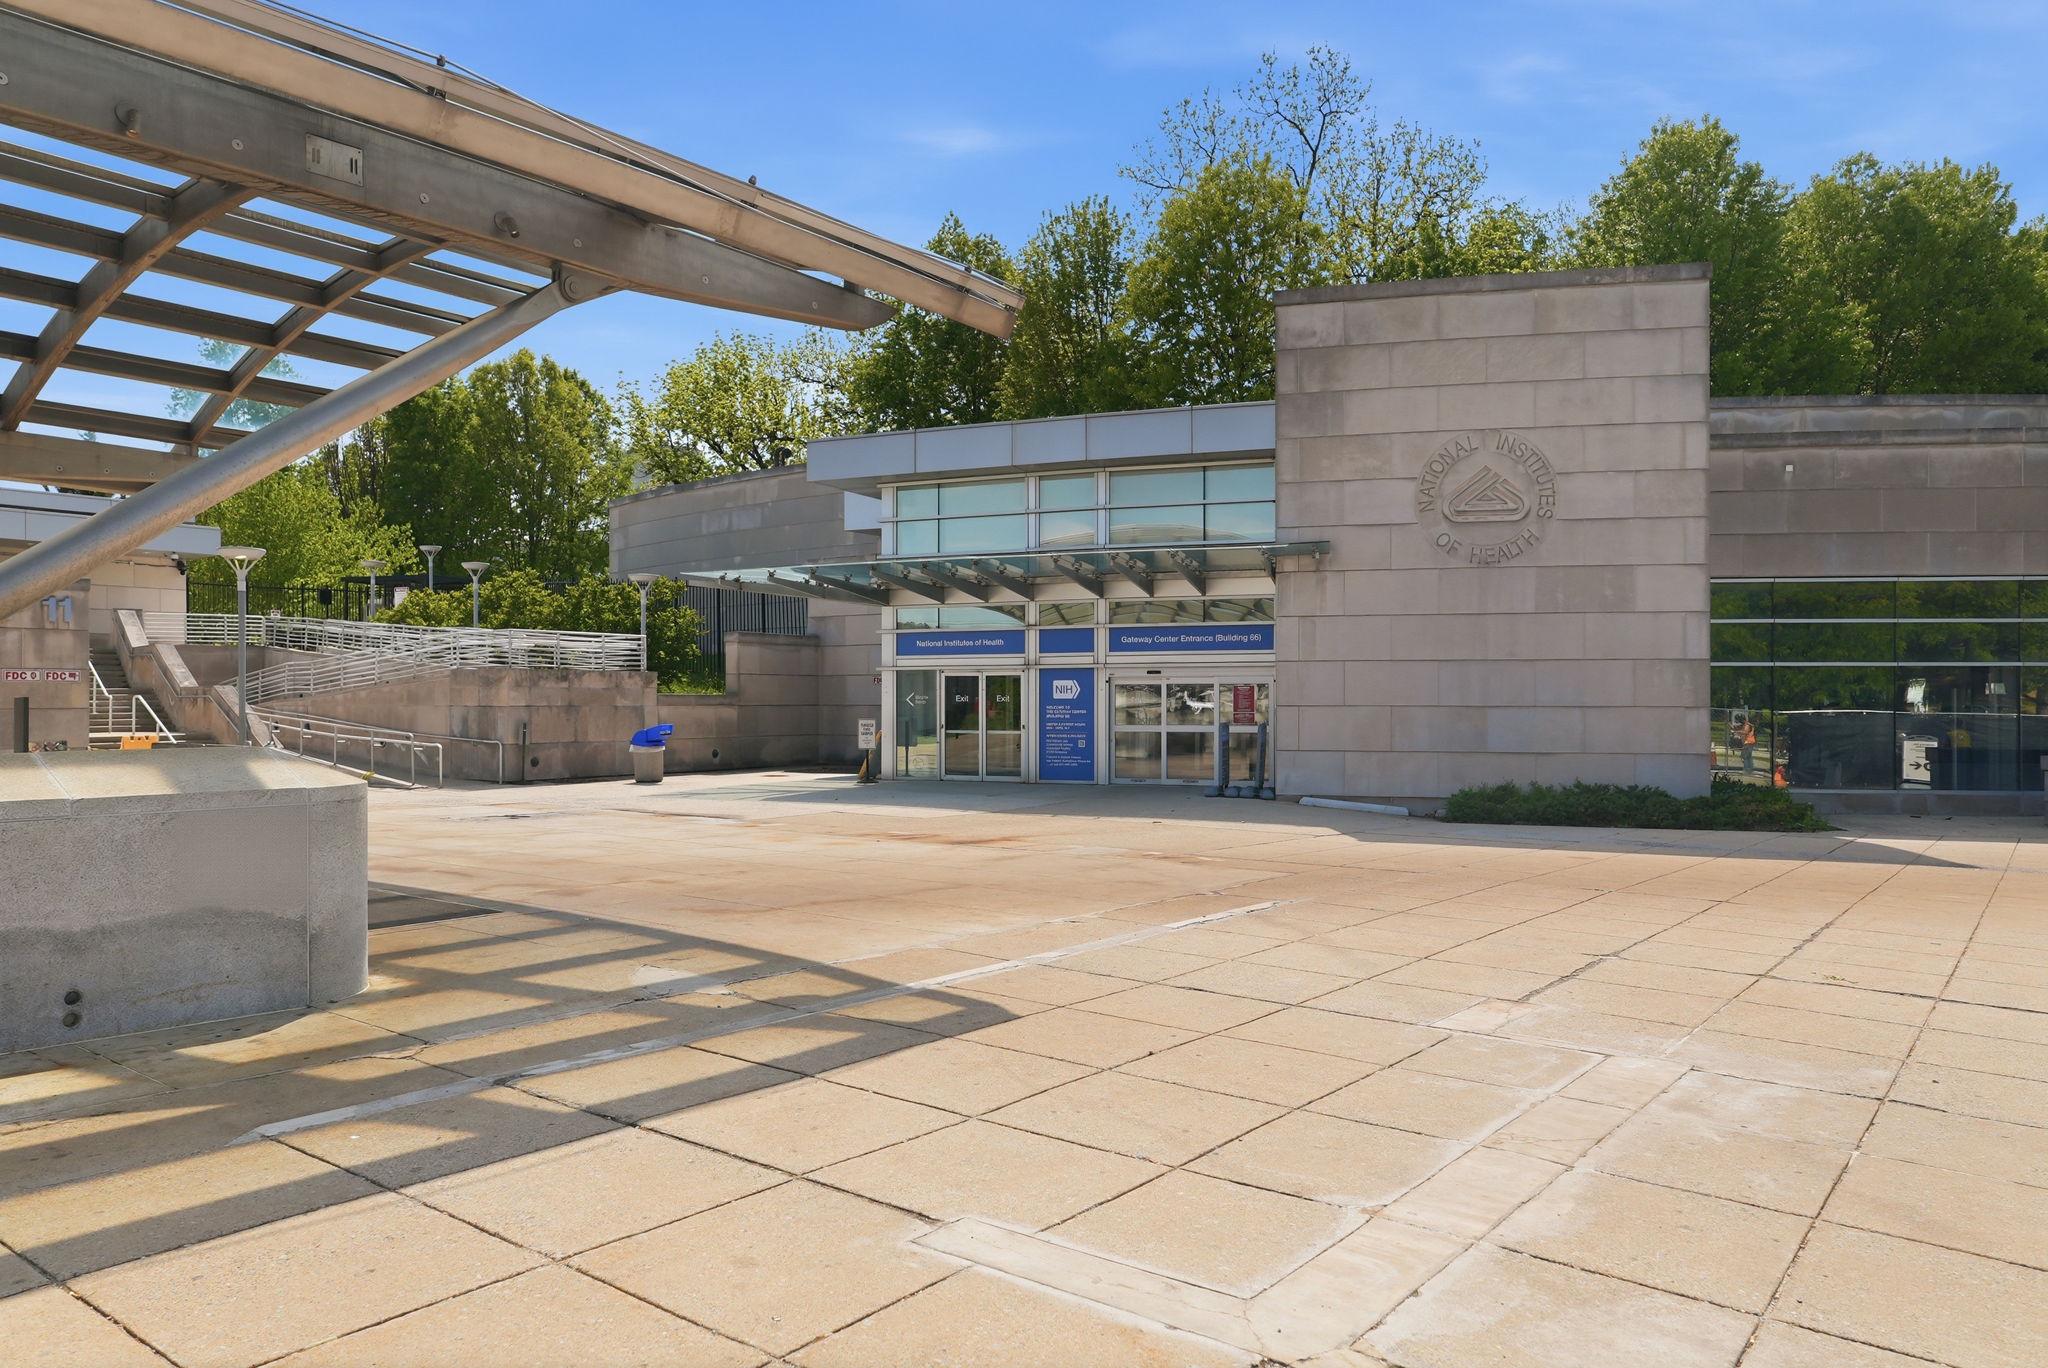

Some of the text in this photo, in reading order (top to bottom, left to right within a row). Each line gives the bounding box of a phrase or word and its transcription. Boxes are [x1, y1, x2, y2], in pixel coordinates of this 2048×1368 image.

[1417, 434, 1556, 519] NATIONAL INSTITUTES
[1436, 528, 1539, 564] OF HEALTH
[42, 595, 73, 625] 11
[1121, 636, 1152, 644] Gateway
[1154, 635, 1179, 643] Center
[1215, 634, 1248, 643] (Building
[1249, 633, 1262, 642] 66)
[5, 671, 27, 680] FDC
[45, 671, 67, 680] FDC
[1055, 685, 1073, 694] NIH
[955, 694, 969, 702] Exit
[996, 694, 1010, 702] Exit
